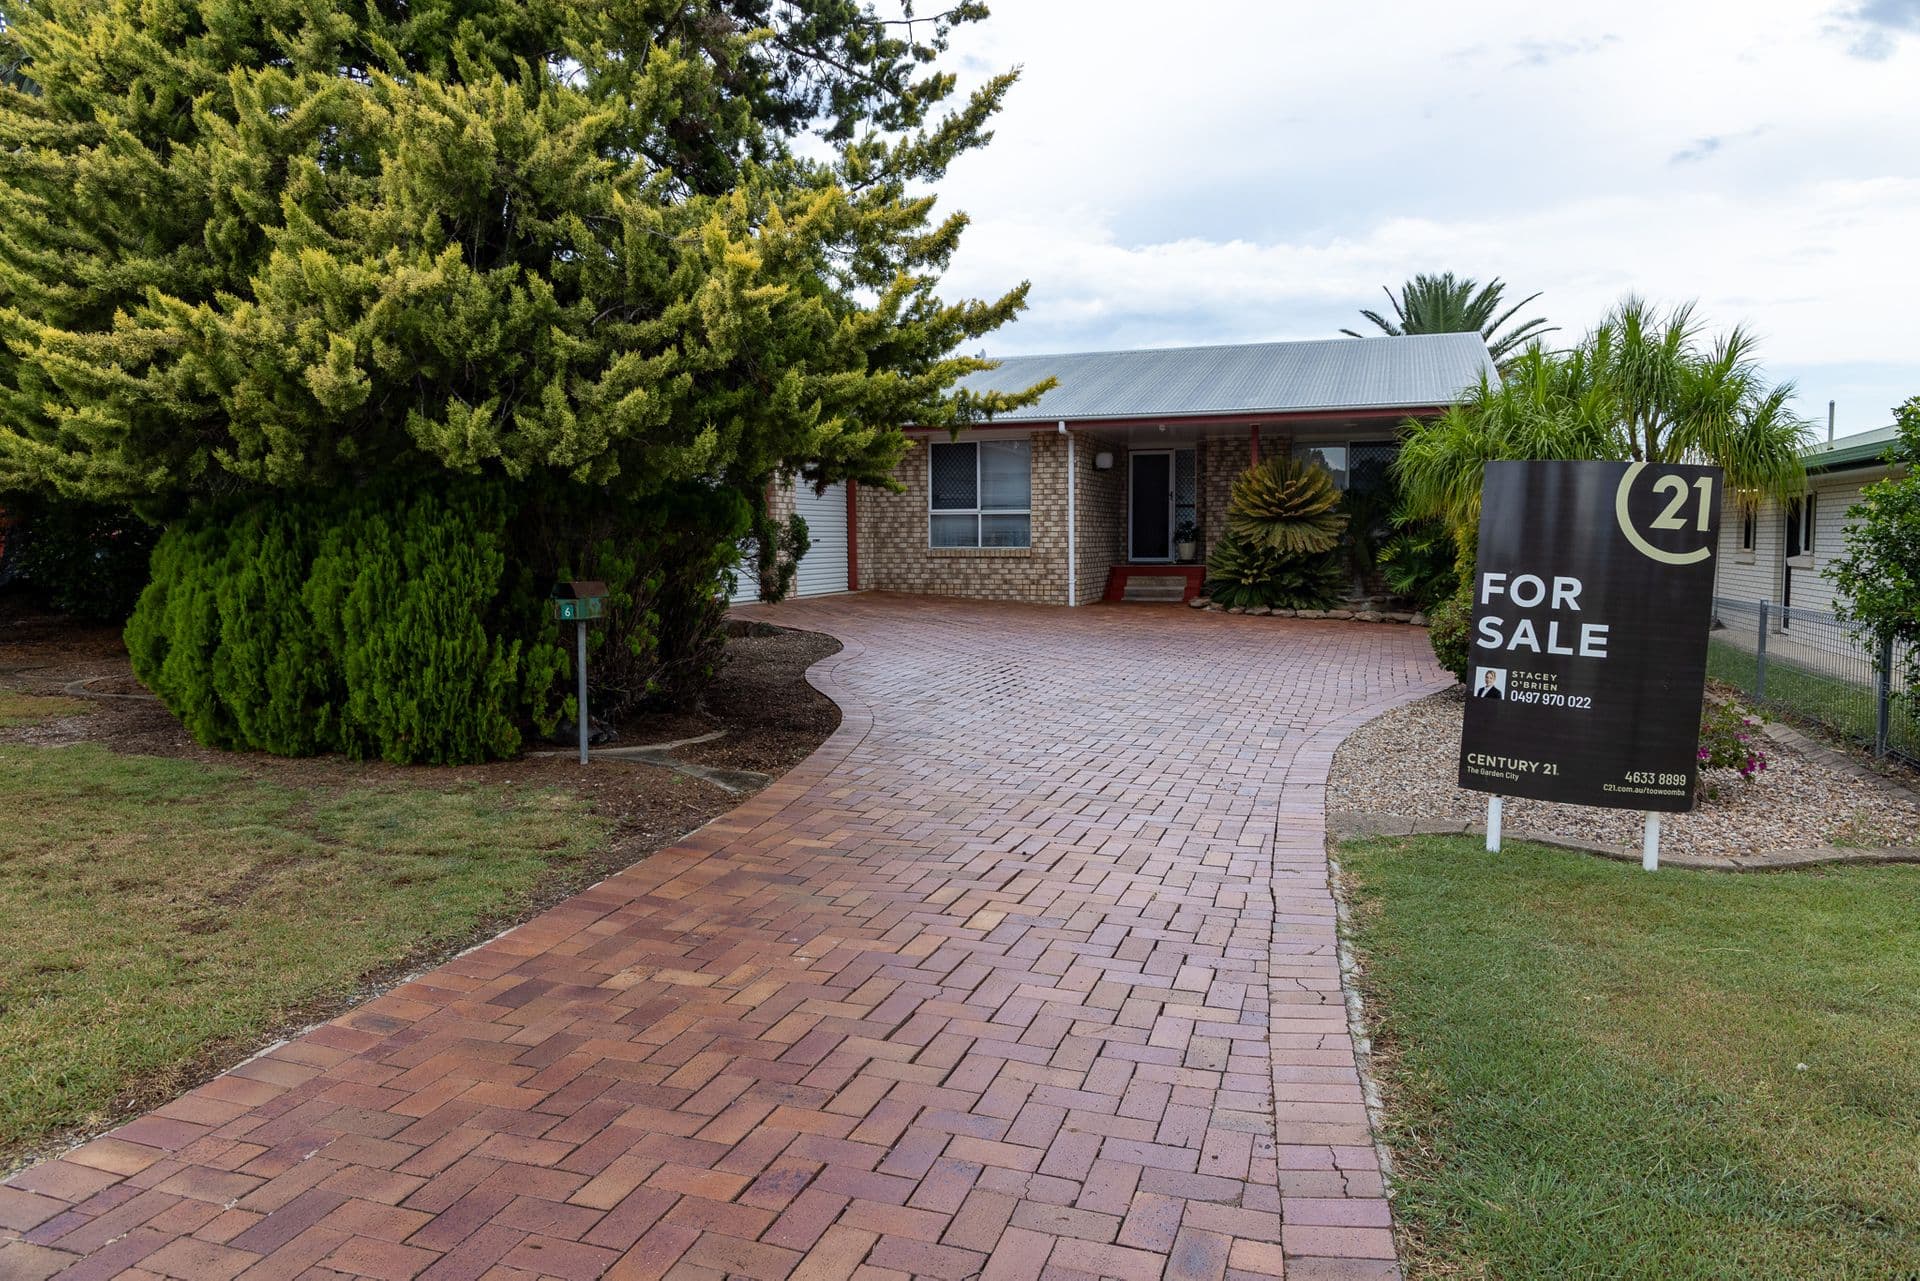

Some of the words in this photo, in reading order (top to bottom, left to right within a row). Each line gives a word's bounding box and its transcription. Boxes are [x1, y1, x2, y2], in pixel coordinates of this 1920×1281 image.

[1649, 474, 1713, 532] 21
[1481, 572, 1583, 611] FOR
[564, 607, 571, 617] 6
[1476, 615, 1610, 658] SALE
[1512, 670, 1557, 681] STACEY
[1511, 680, 1558, 691] O'BRIEN
[1510, 690, 1540, 704] 0497
[1542, 693, 1565, 706] 970
[1567, 695, 1592, 709] 022
[1467, 753, 1540, 773] CENTURY
[1542, 763, 1557, 776] 21
[1467, 766, 1479, 775] The
[1480, 767, 1504, 778] Garden
[1505, 771, 1520, 781] City
[1625, 771, 1656, 785] 4633
[1658, 773, 1687, 786] 8899
[1603, 783, 1686, 796] C21.com.au/toowoomba
